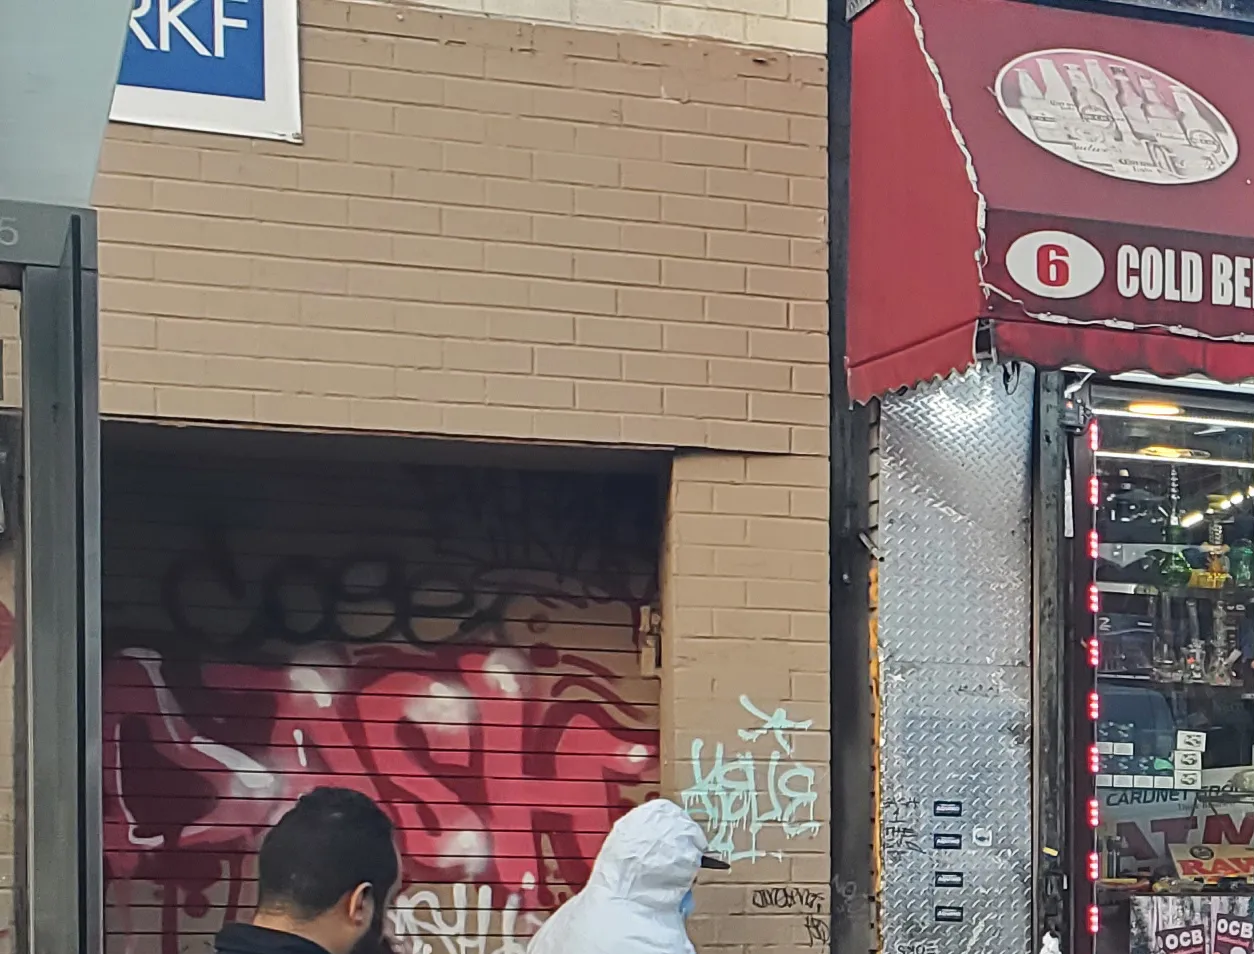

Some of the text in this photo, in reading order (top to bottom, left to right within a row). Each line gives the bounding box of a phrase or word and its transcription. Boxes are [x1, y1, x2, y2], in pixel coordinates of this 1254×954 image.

[1036, 243, 1071, 288] 6
[1117, 244, 1203, 304] COLD
[1165, 929, 1204, 950] OCB
[1217, 918, 1254, 939] OCB
